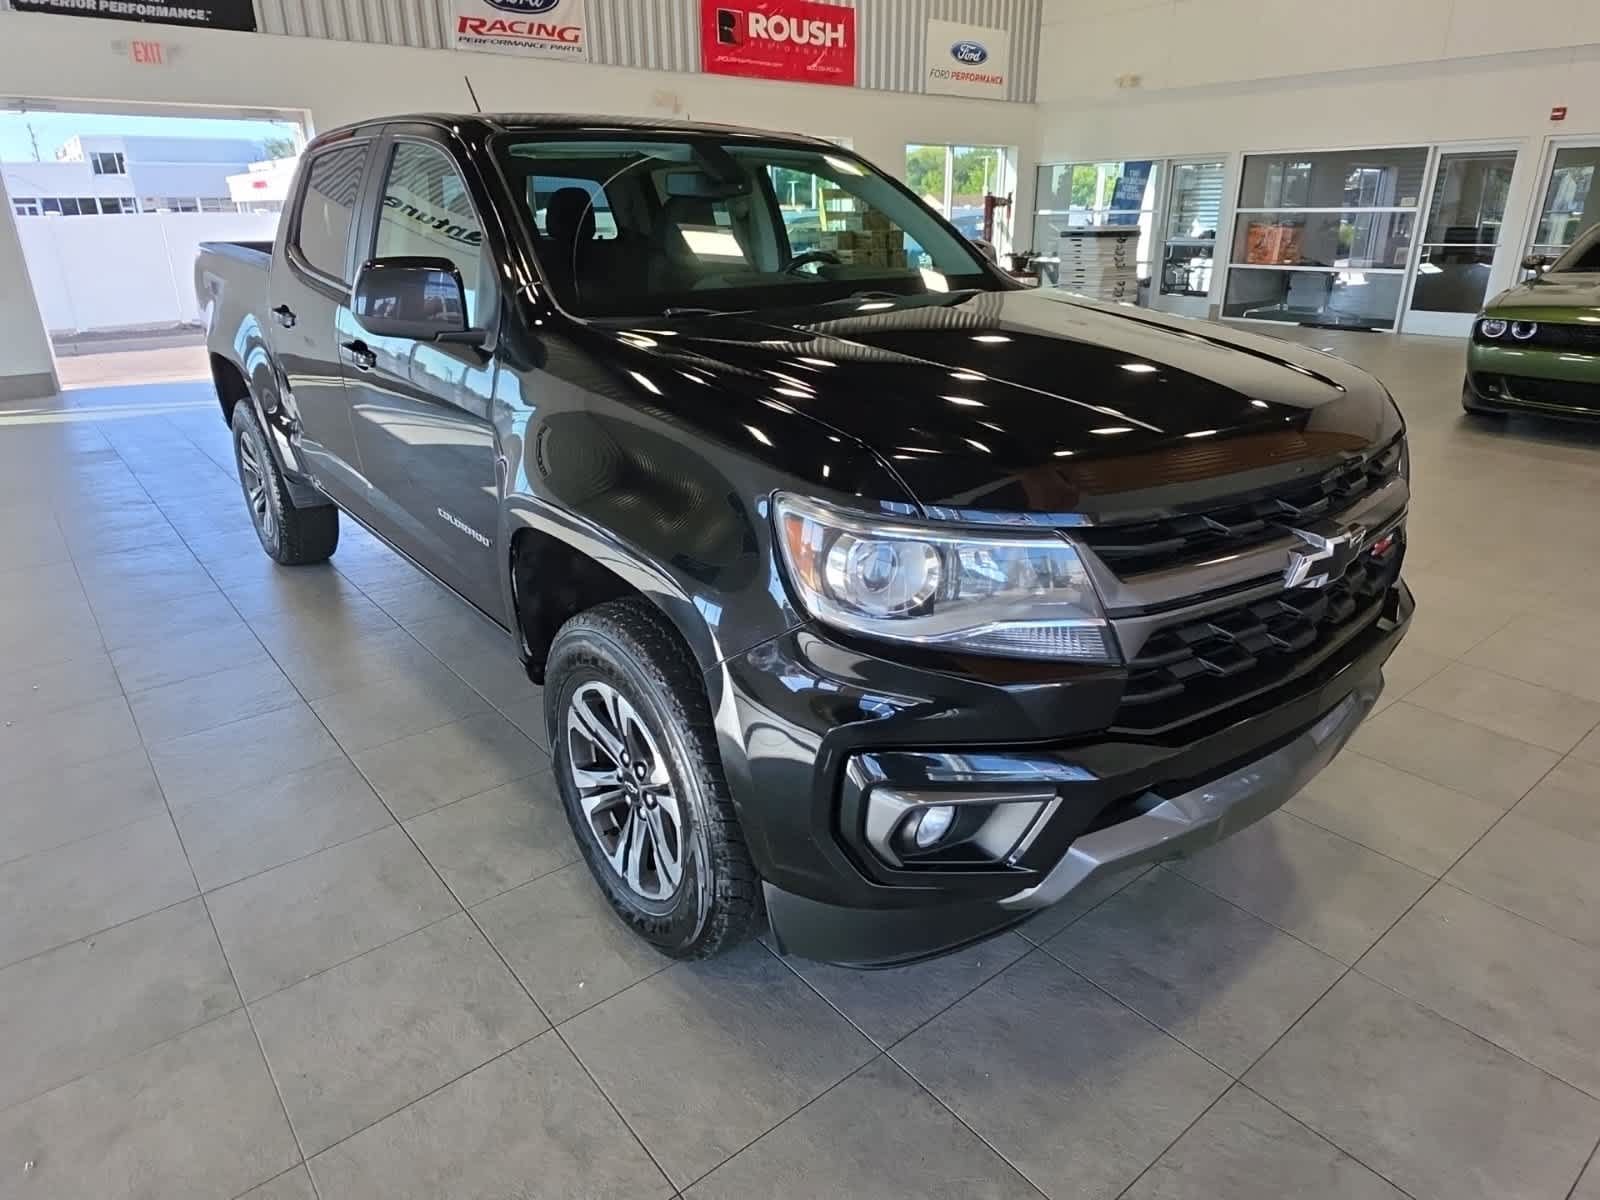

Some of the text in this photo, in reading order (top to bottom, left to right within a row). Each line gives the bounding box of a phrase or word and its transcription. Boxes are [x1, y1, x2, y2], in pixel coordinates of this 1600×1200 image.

[458, 16, 581, 43] RACING
[748, 12, 845, 48] ROUSH
[132, 41, 162, 64] EXIT
[458, 36, 583, 53] PERFORMANCE PARTS
[958, 45, 981, 61] Ford
[929, 68, 950, 80] FORD
[437, 507, 490, 548] COLORADO
